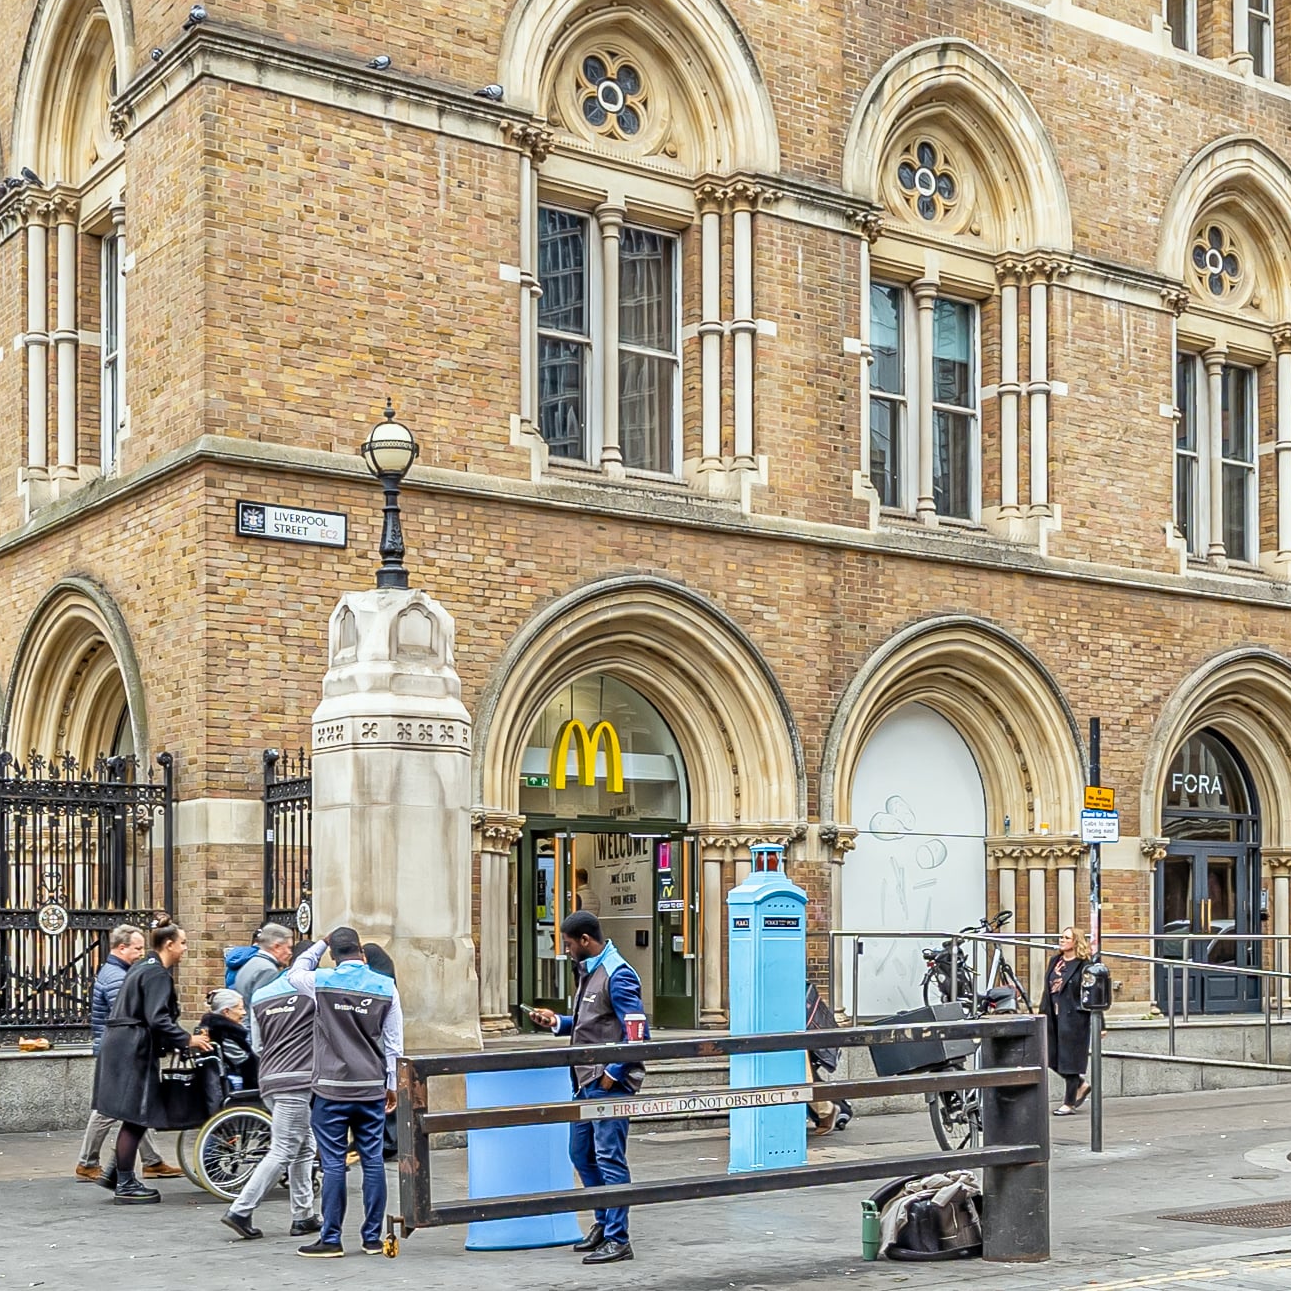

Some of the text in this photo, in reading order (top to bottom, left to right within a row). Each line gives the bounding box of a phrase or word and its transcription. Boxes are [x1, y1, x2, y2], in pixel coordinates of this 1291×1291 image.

[274, 511, 329, 528] LIVERPOOL
[274, 523, 339, 541] STREET EC2
[1172, 773, 1223, 795] FORA
[597, 833, 649, 861] WELCOME
[612, 1091, 786, 1117] FIRE GATE DO NOT OBSTRUCT
